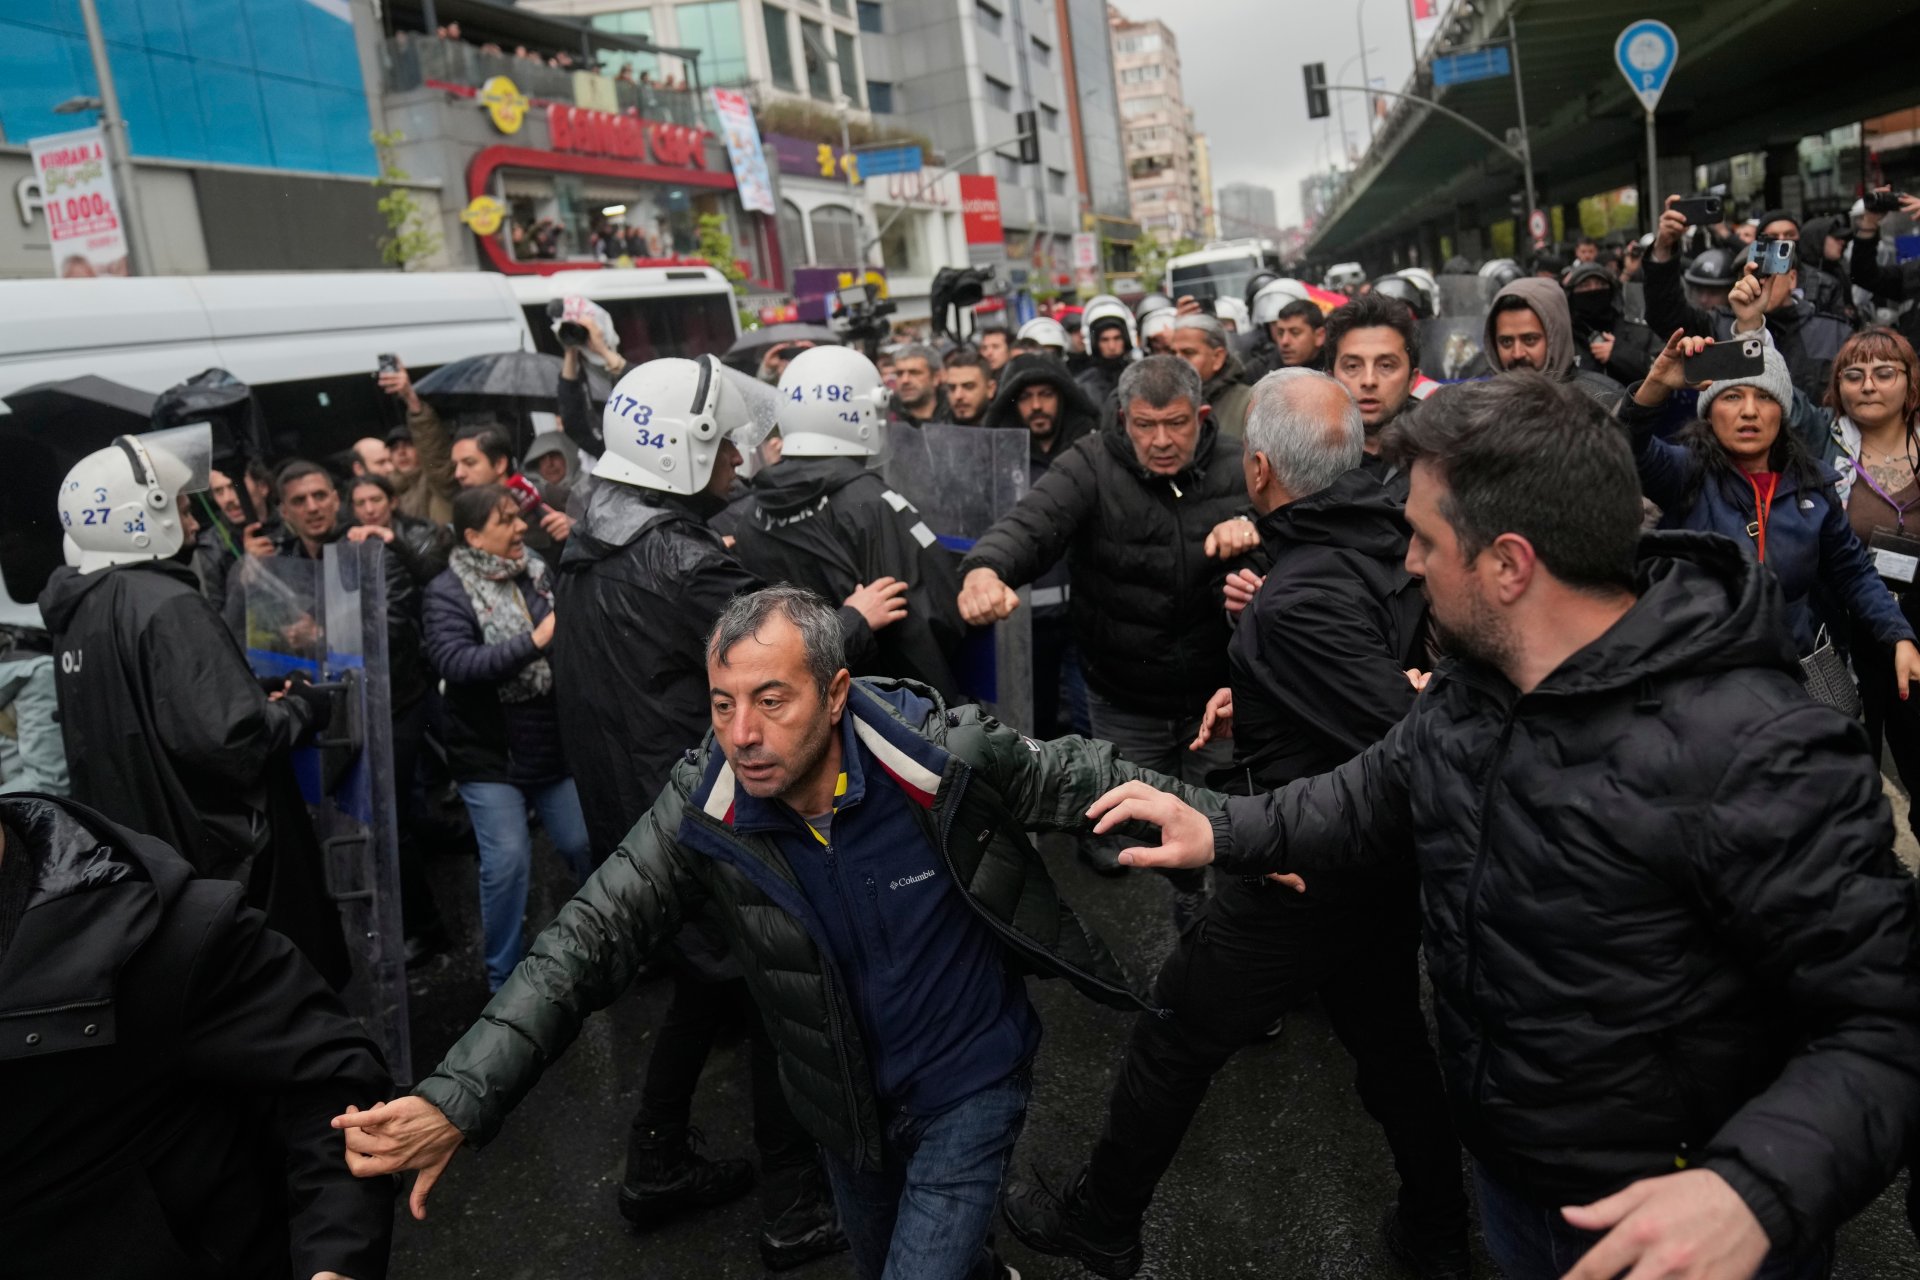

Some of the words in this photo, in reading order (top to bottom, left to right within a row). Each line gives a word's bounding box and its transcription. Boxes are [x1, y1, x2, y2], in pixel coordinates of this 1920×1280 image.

[636, 429, 665, 449] 34
[82, 508, 111, 525] 27
[123, 521, 146, 534] 34
[898, 869, 936, 887] Columbia
